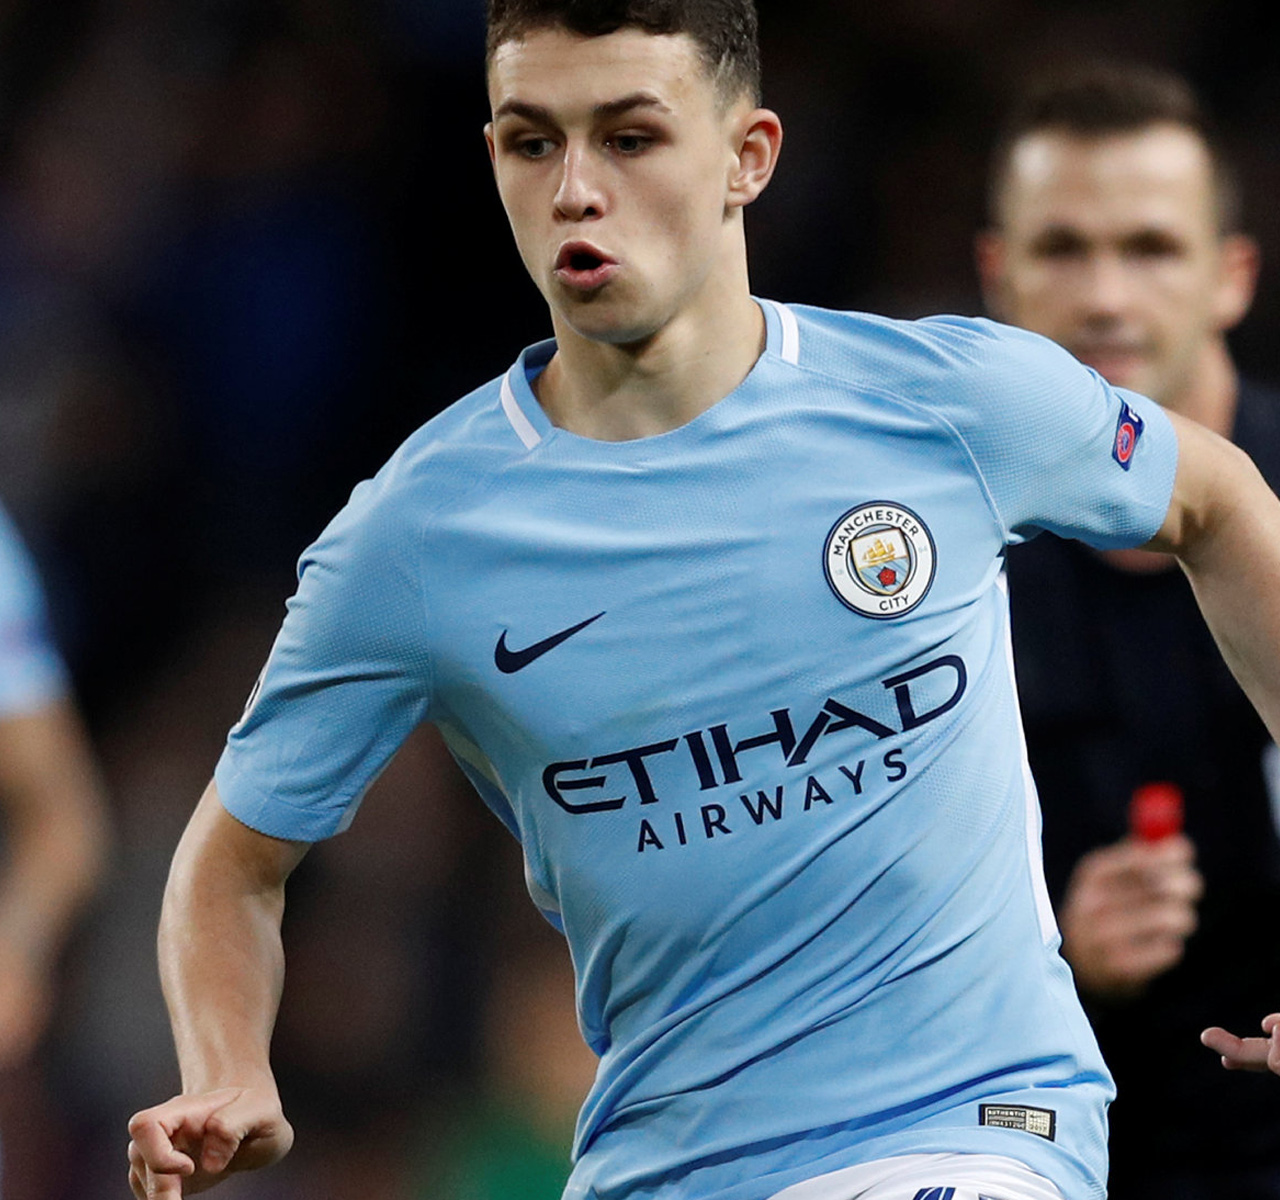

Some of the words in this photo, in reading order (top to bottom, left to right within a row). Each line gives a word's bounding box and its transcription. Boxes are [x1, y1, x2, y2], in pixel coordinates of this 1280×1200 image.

[833, 509, 919, 556] MANCHESTER
[879, 594, 909, 611] CITY
[541, 653, 968, 815] ETIHAD
[636, 747, 908, 853] AIRWAYS
